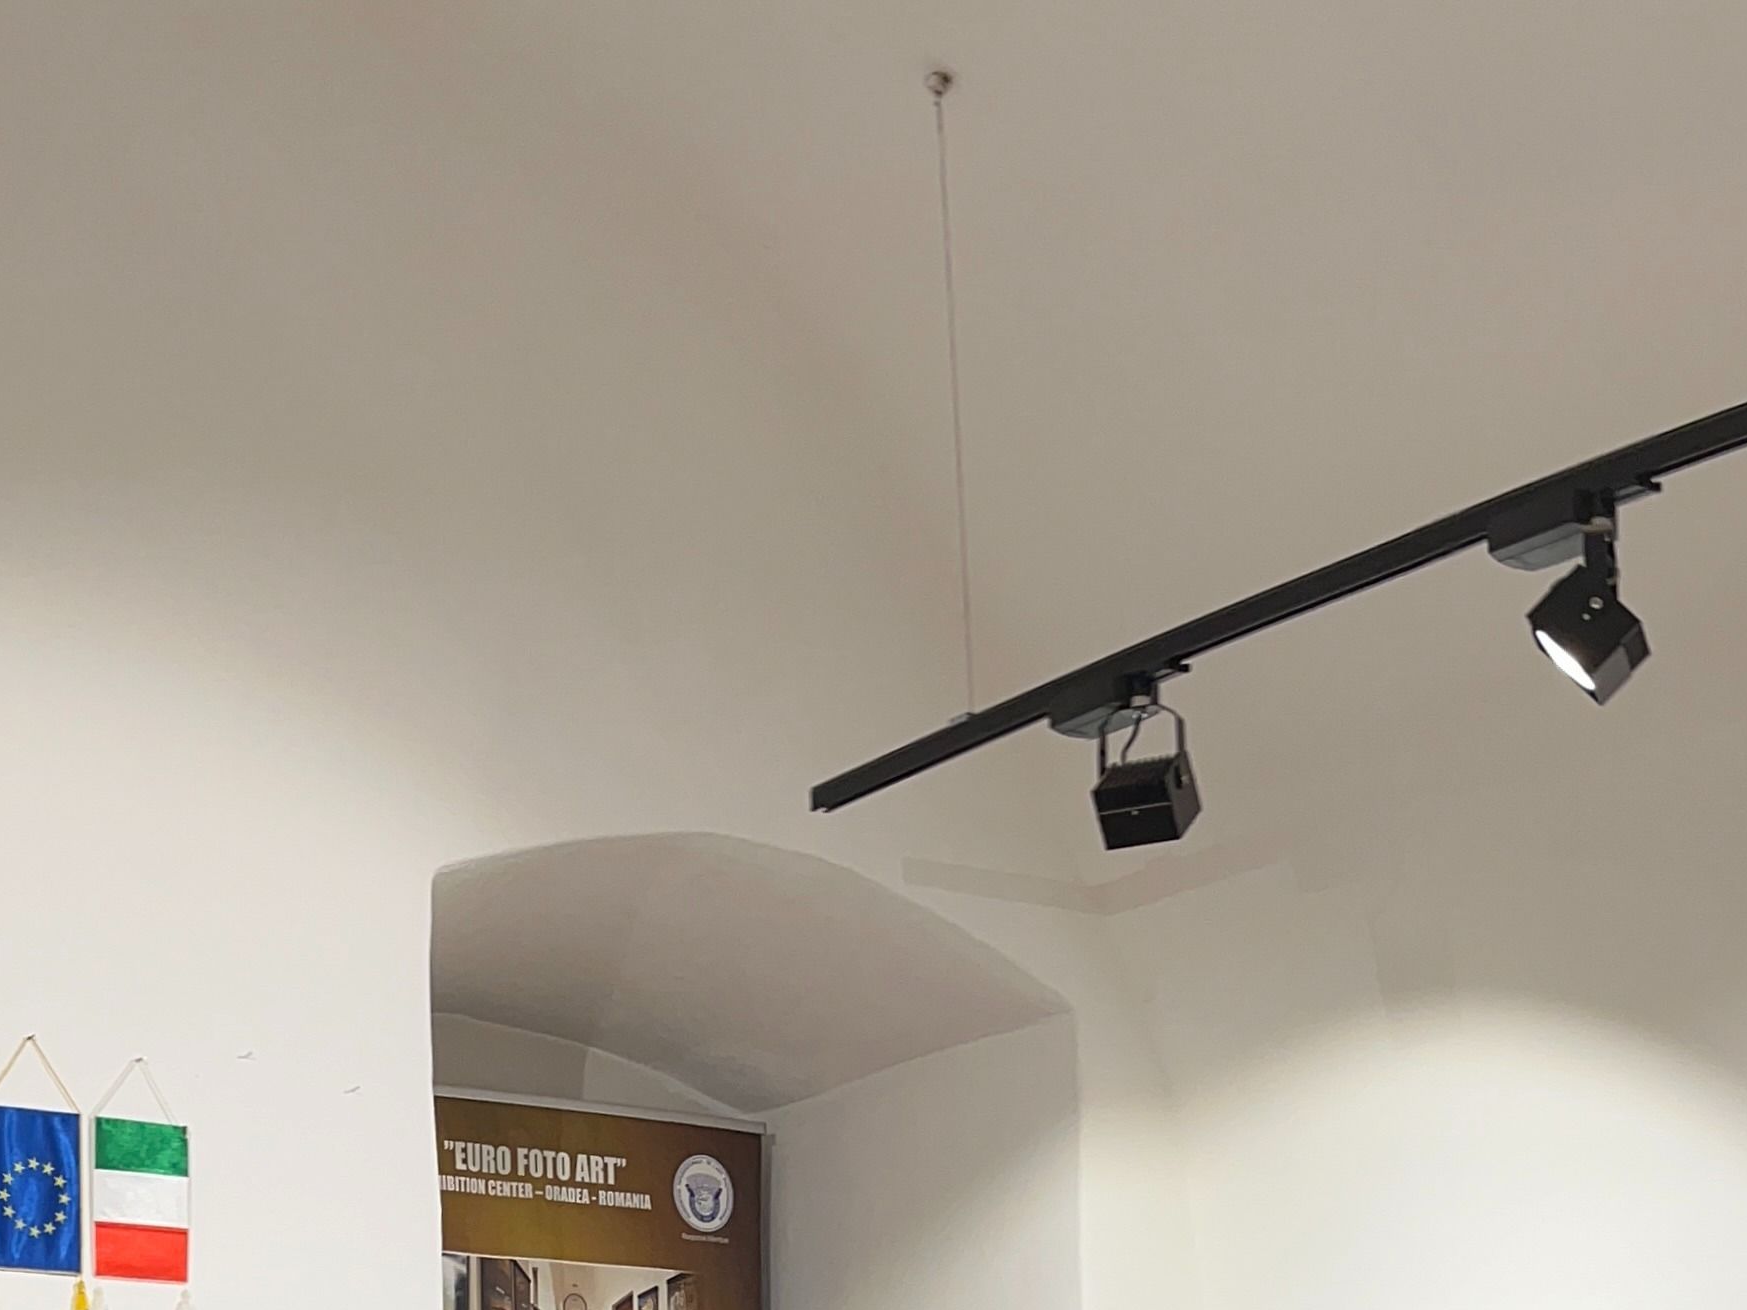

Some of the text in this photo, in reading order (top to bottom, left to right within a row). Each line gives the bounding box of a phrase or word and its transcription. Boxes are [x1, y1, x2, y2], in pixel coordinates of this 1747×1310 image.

[517, 1148, 570, 1181] FOTO
[488, 1180, 532, 1199] CENTER
[545, 1185, 590, 1204] ORADEA
[599, 1190, 652, 1210] ROMANIA
